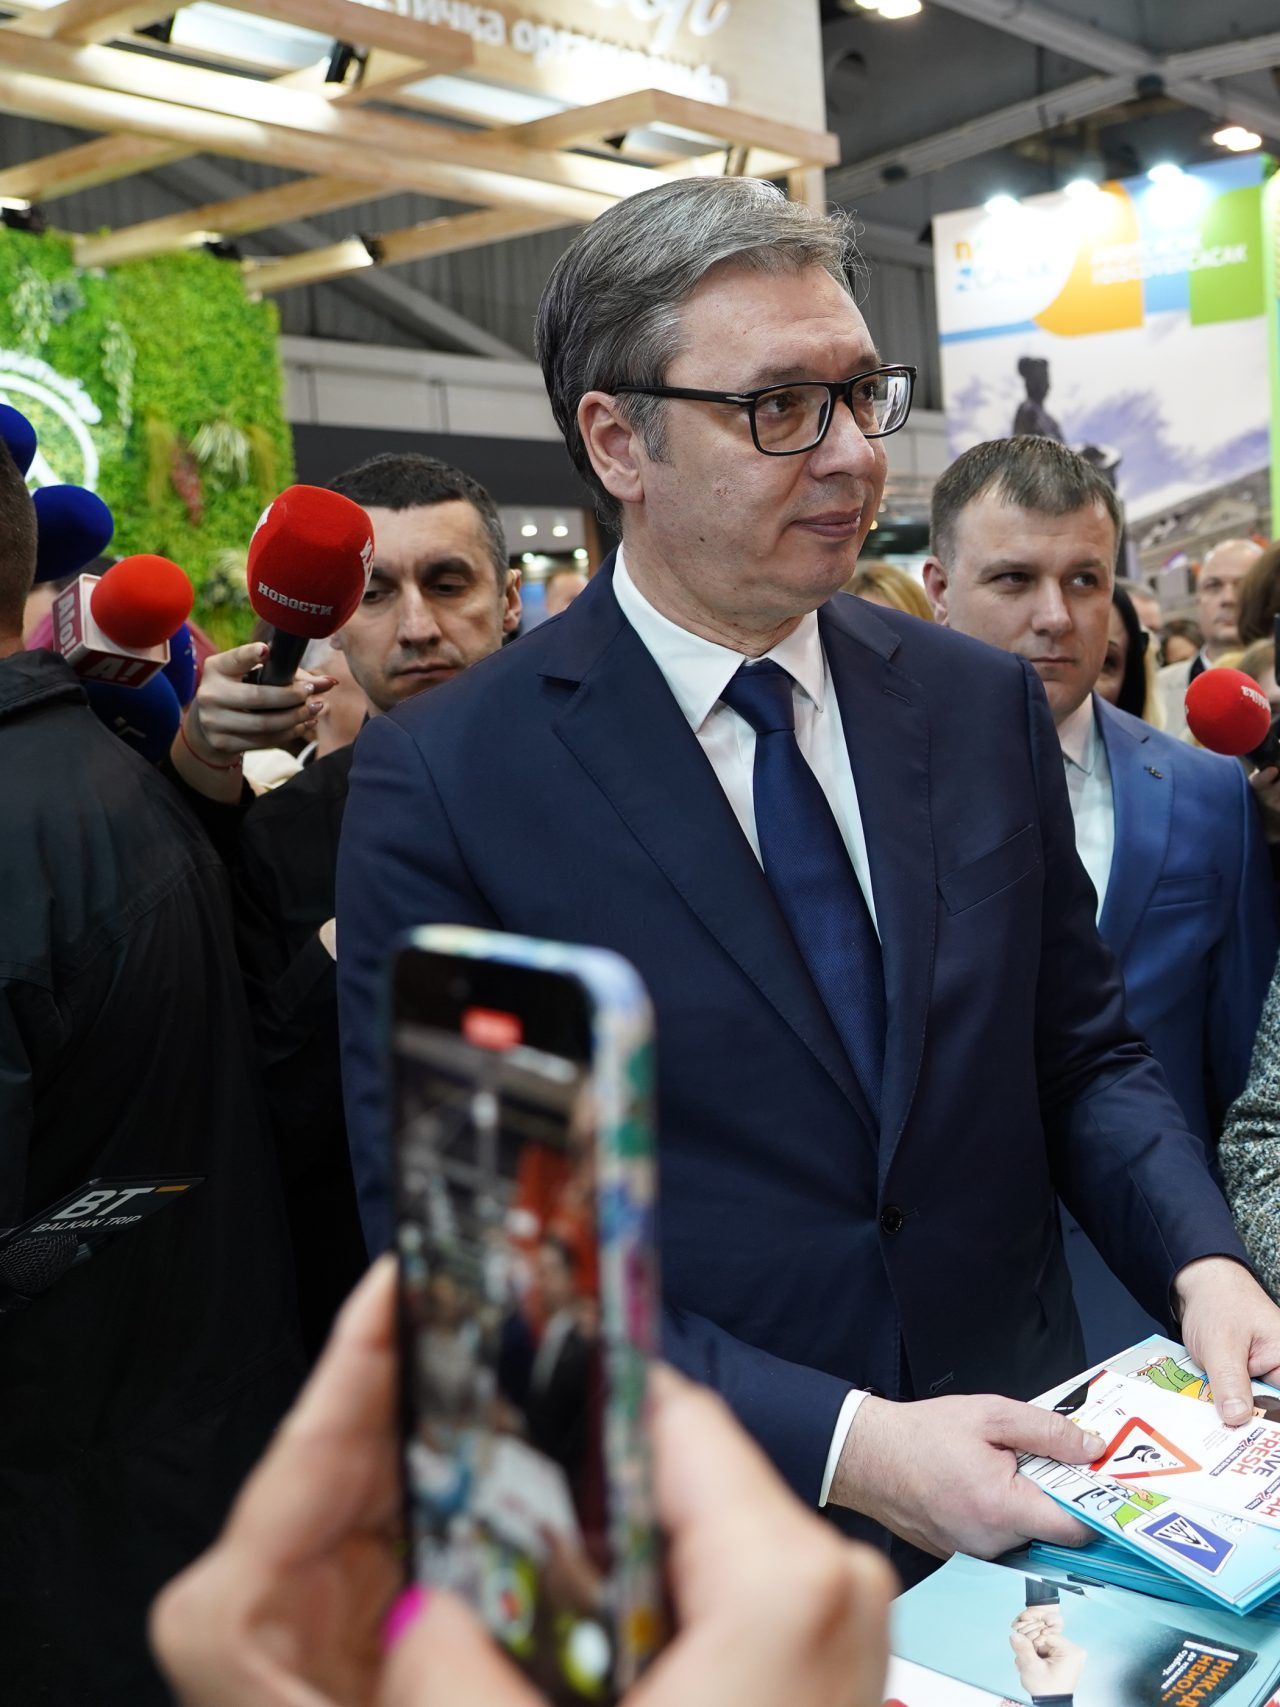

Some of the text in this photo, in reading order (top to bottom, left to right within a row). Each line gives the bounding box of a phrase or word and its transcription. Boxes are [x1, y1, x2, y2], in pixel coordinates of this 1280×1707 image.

[258, 581, 333, 615] НОВОСТИ
[51, 1187, 156, 1220] BT
[31, 1215, 143, 1232] BALKAN TRIP
[1175, 1660, 1233, 1707] НИКАД
